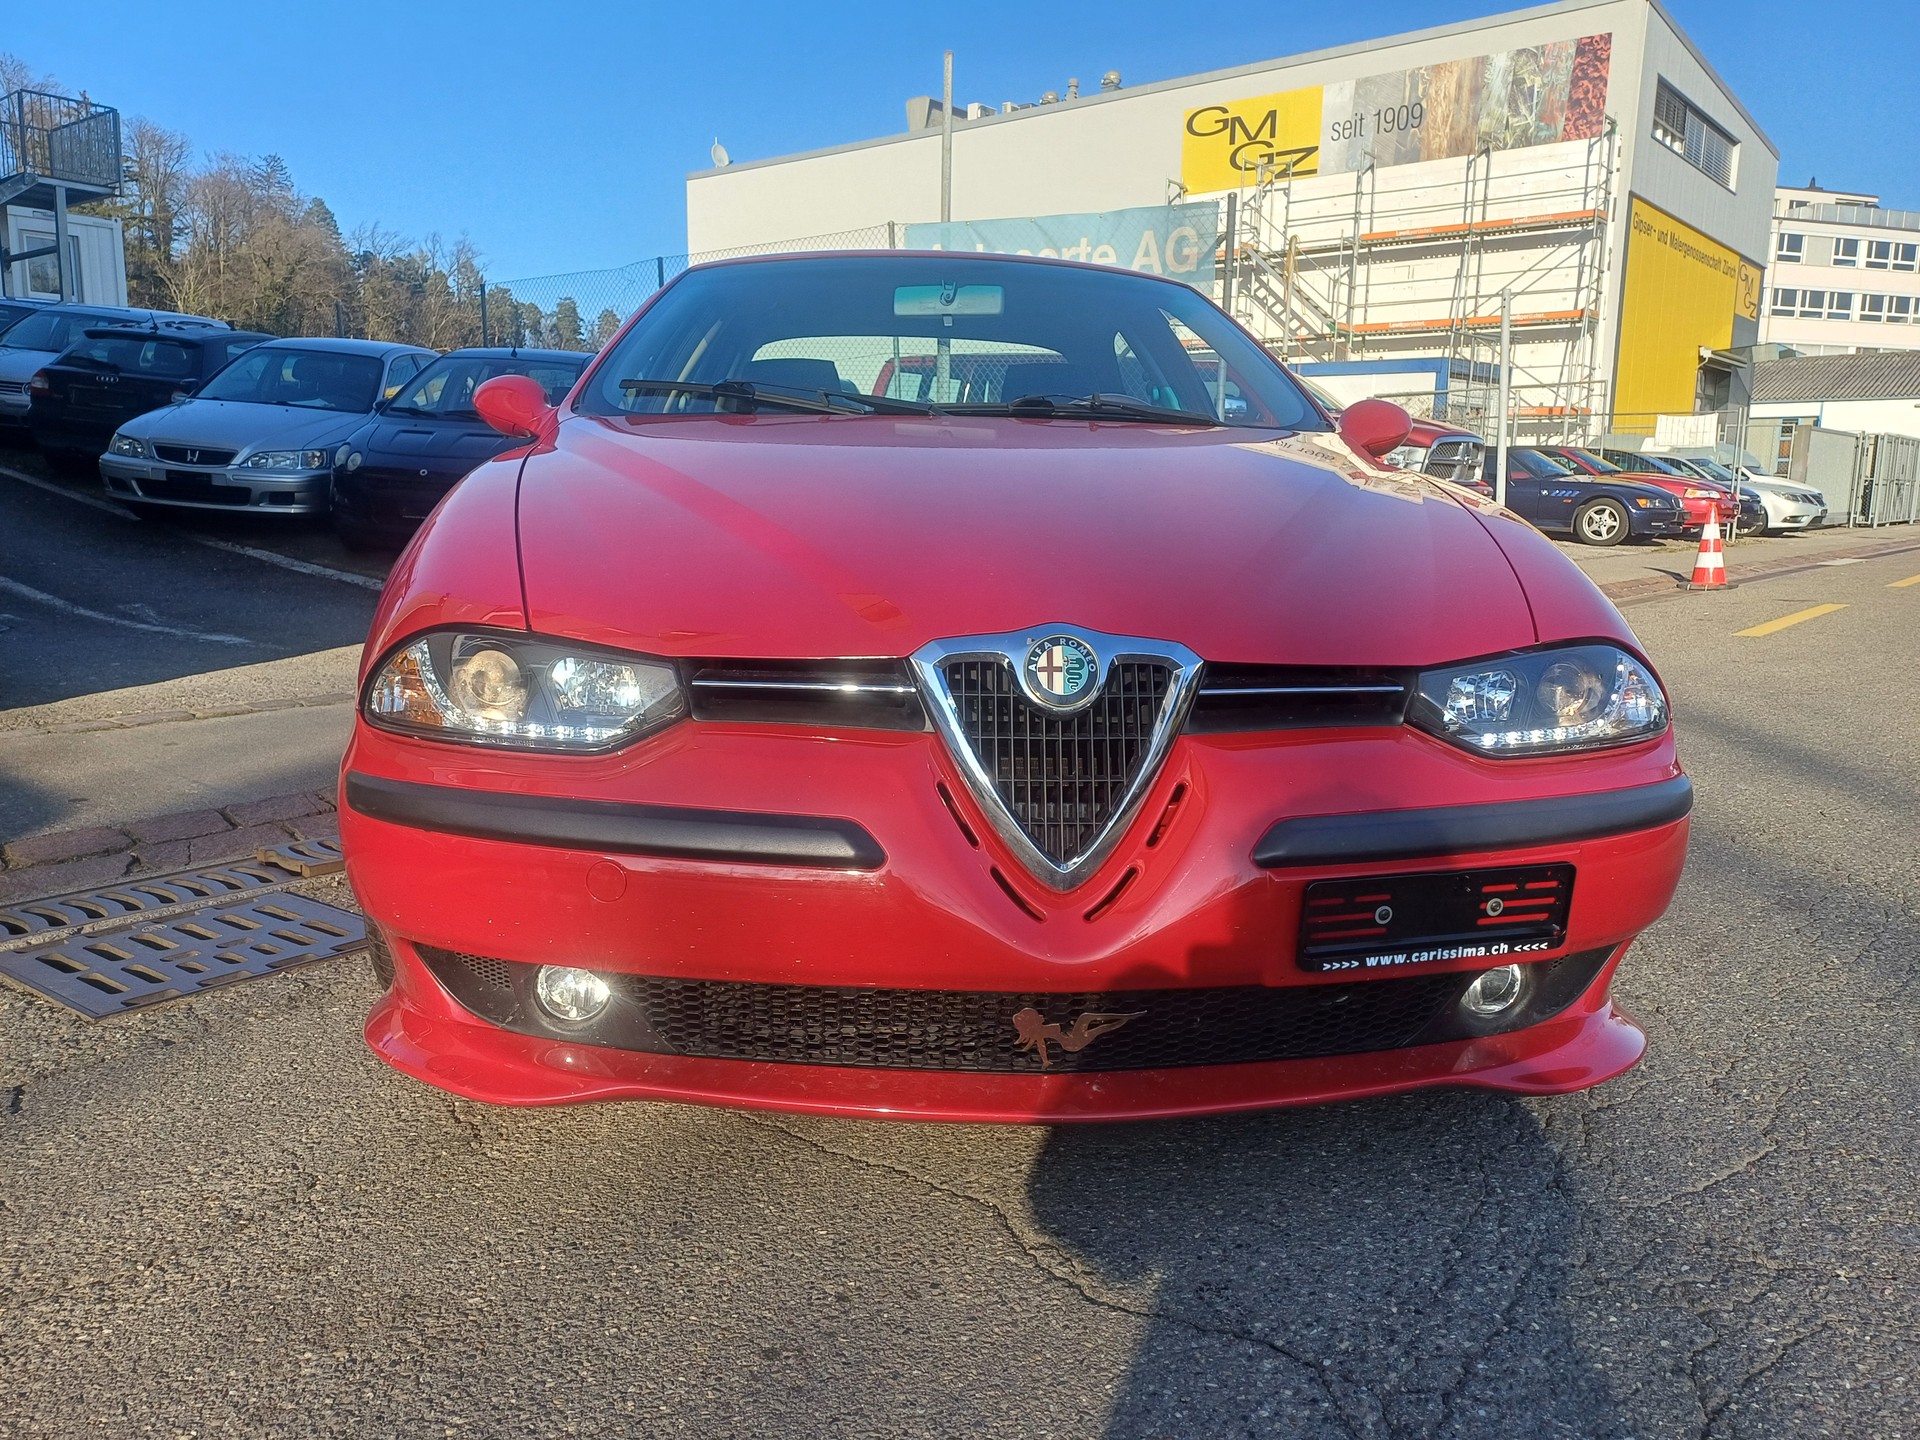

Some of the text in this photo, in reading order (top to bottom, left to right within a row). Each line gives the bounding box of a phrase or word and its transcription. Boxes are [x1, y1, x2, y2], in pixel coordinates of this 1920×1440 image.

[1331, 102, 1424, 142] seit 1909
[1131, 226, 1199, 275] AG
[1657, 229, 1668, 245] und
[1722, 259, 1737, 279] Zürich
[1028, 638, 1096, 672] ALFA ROMEO
[1365, 942, 1509, 967] www.carissima.ch
